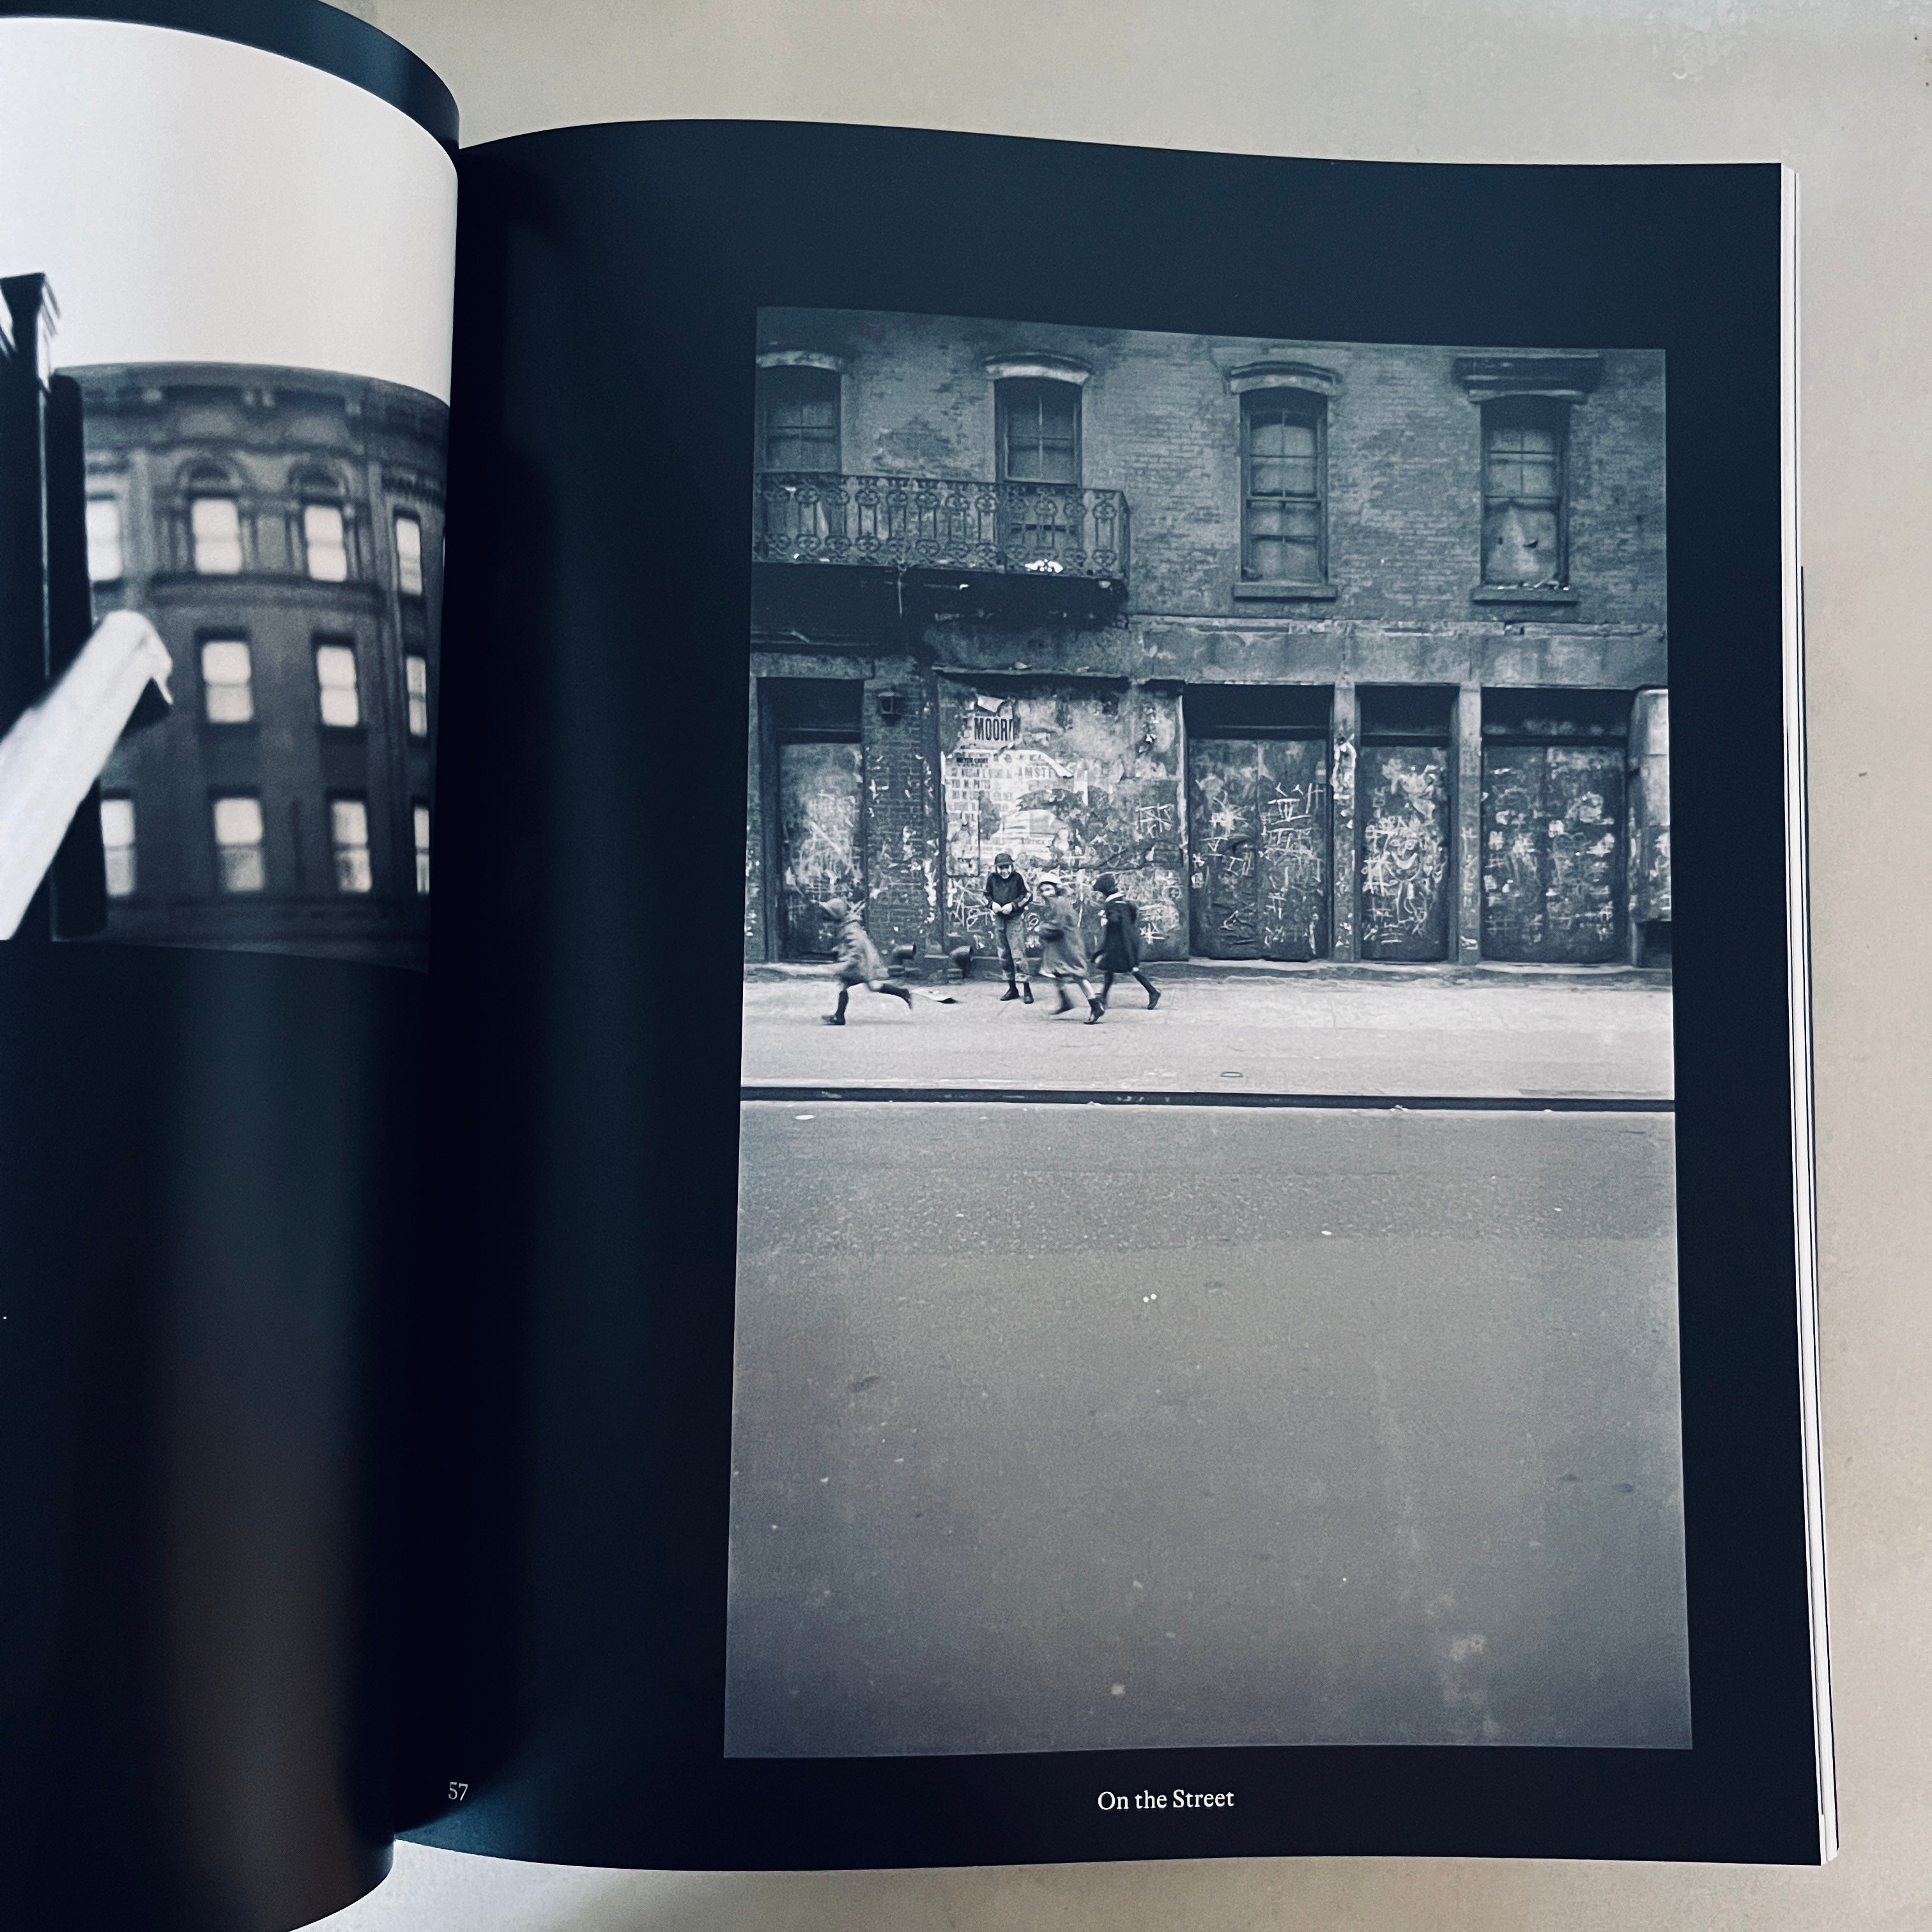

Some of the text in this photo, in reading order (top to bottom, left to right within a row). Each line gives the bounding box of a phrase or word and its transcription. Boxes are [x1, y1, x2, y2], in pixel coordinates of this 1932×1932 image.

[448, 1781, 468, 1801] 57
[1098, 1789, 1234, 1810] On the Street
